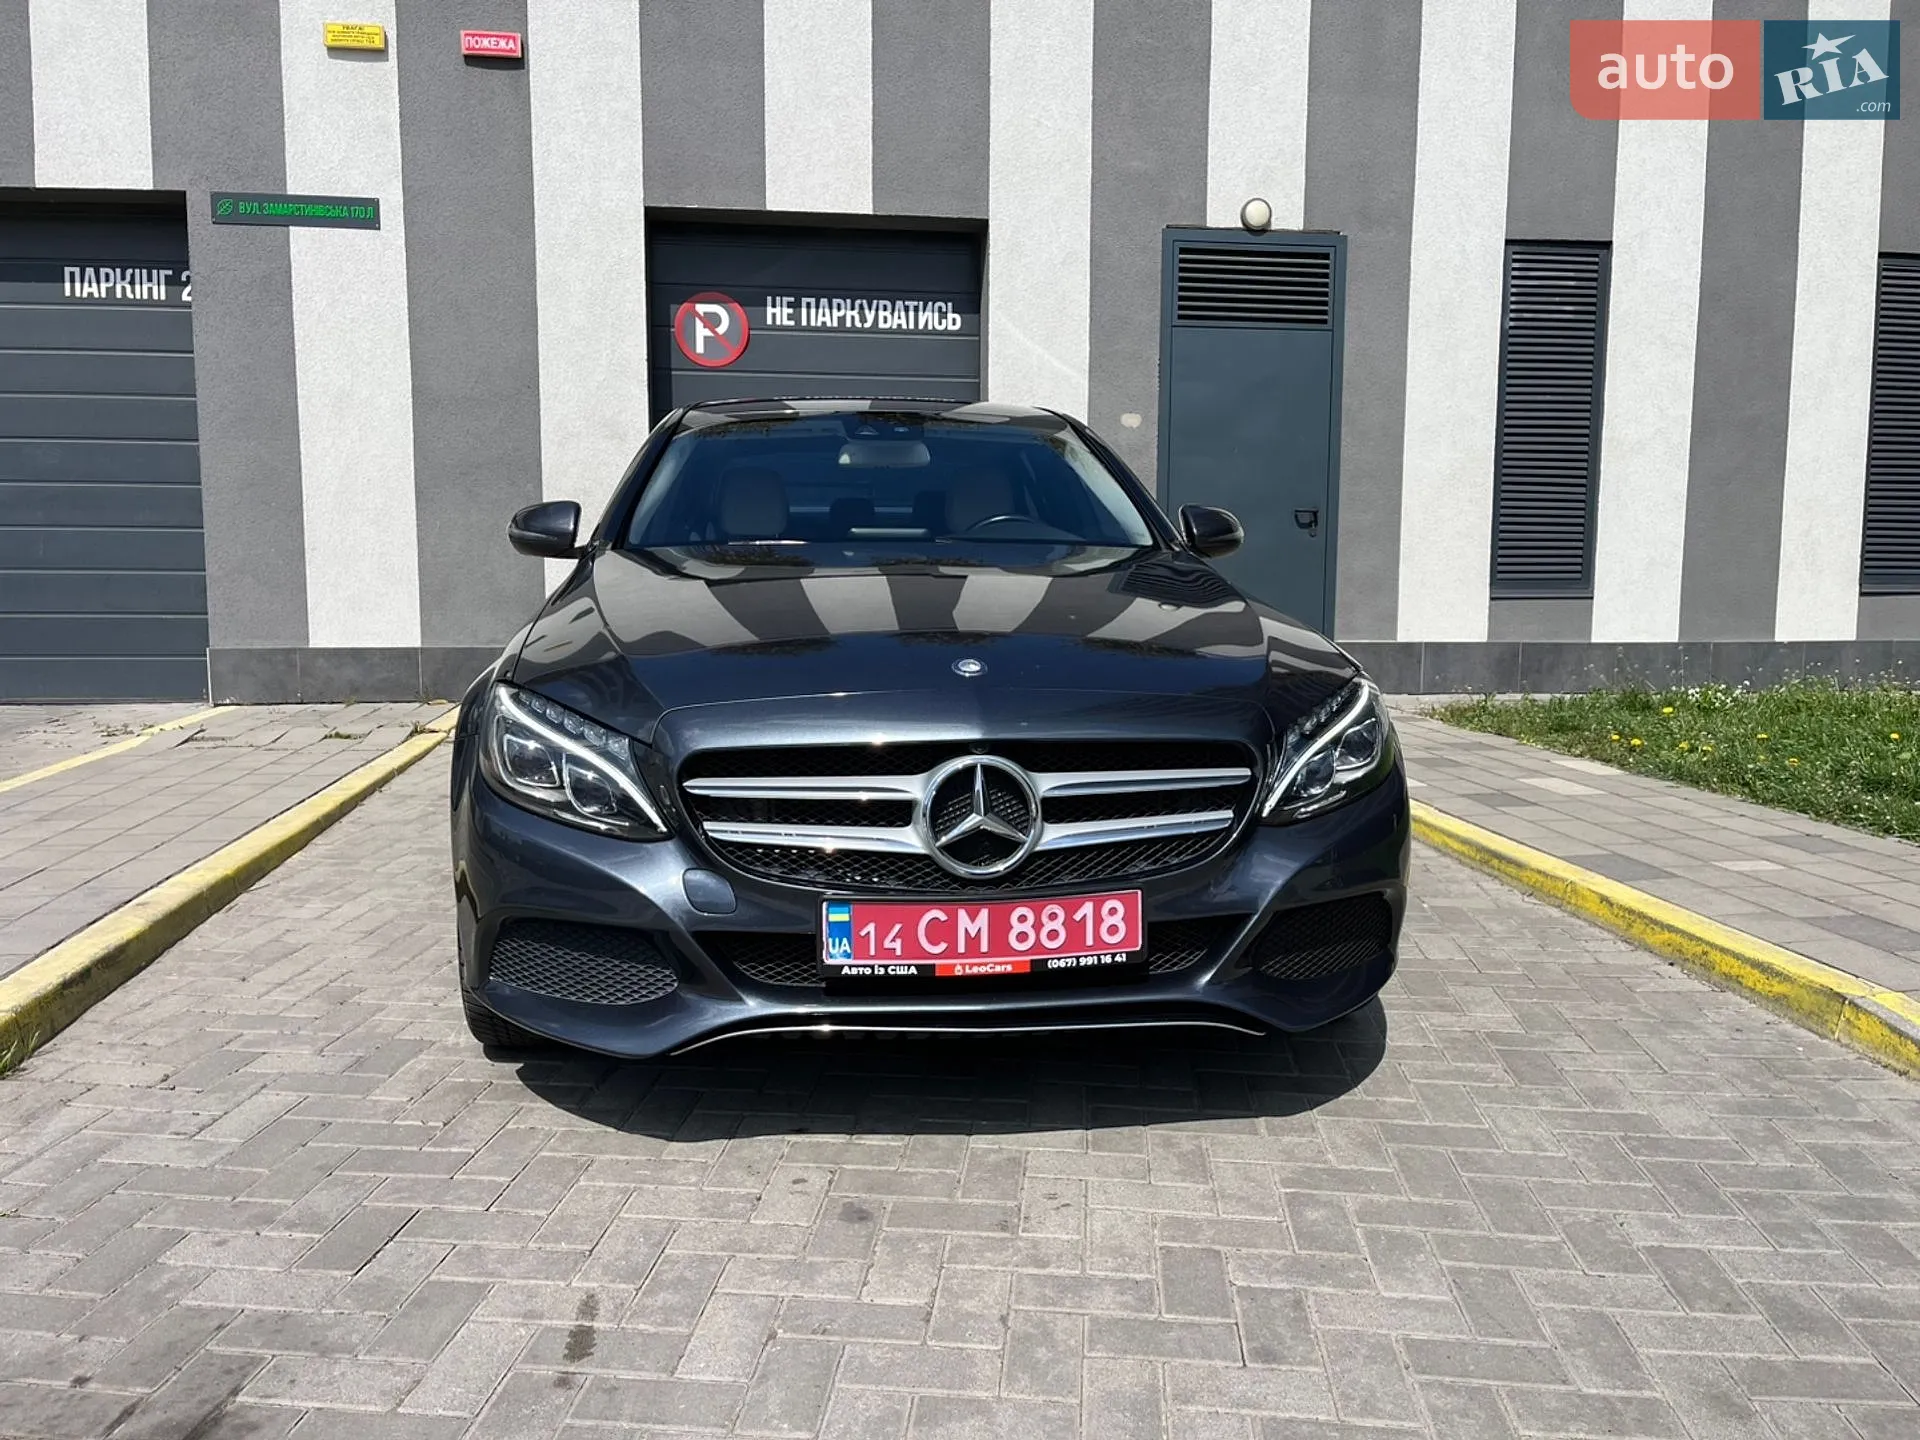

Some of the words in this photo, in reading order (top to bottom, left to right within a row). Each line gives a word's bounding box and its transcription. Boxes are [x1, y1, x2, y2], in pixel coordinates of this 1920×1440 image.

[465, 36, 515, 50] ПОЖЕЖА
[263, 203, 348, 218] ЗАМАРСТИНІВСЬКА
[63, 266, 173, 301] ПАРКІНГ
[766, 296, 795, 326] НЕ
[801, 297, 962, 331] ПАРКУВАТИСЬ
[858, 922, 903, 956] 14
[917, 908, 990, 955] CM
[1007, 899, 1127, 952] 8818
[828, 937, 851, 954] UA
[965, 963, 1013, 974] LeoCars
[1047, 957, 1077, 969] (067)
[1079, 956, 1098, 966] 991
[1100, 955, 1112, 964] 16
[1114, 953, 1126, 963] 41
[841, 965, 873, 975] Авто
[874, 965, 885, 975] із
[887, 965, 918, 975] США
